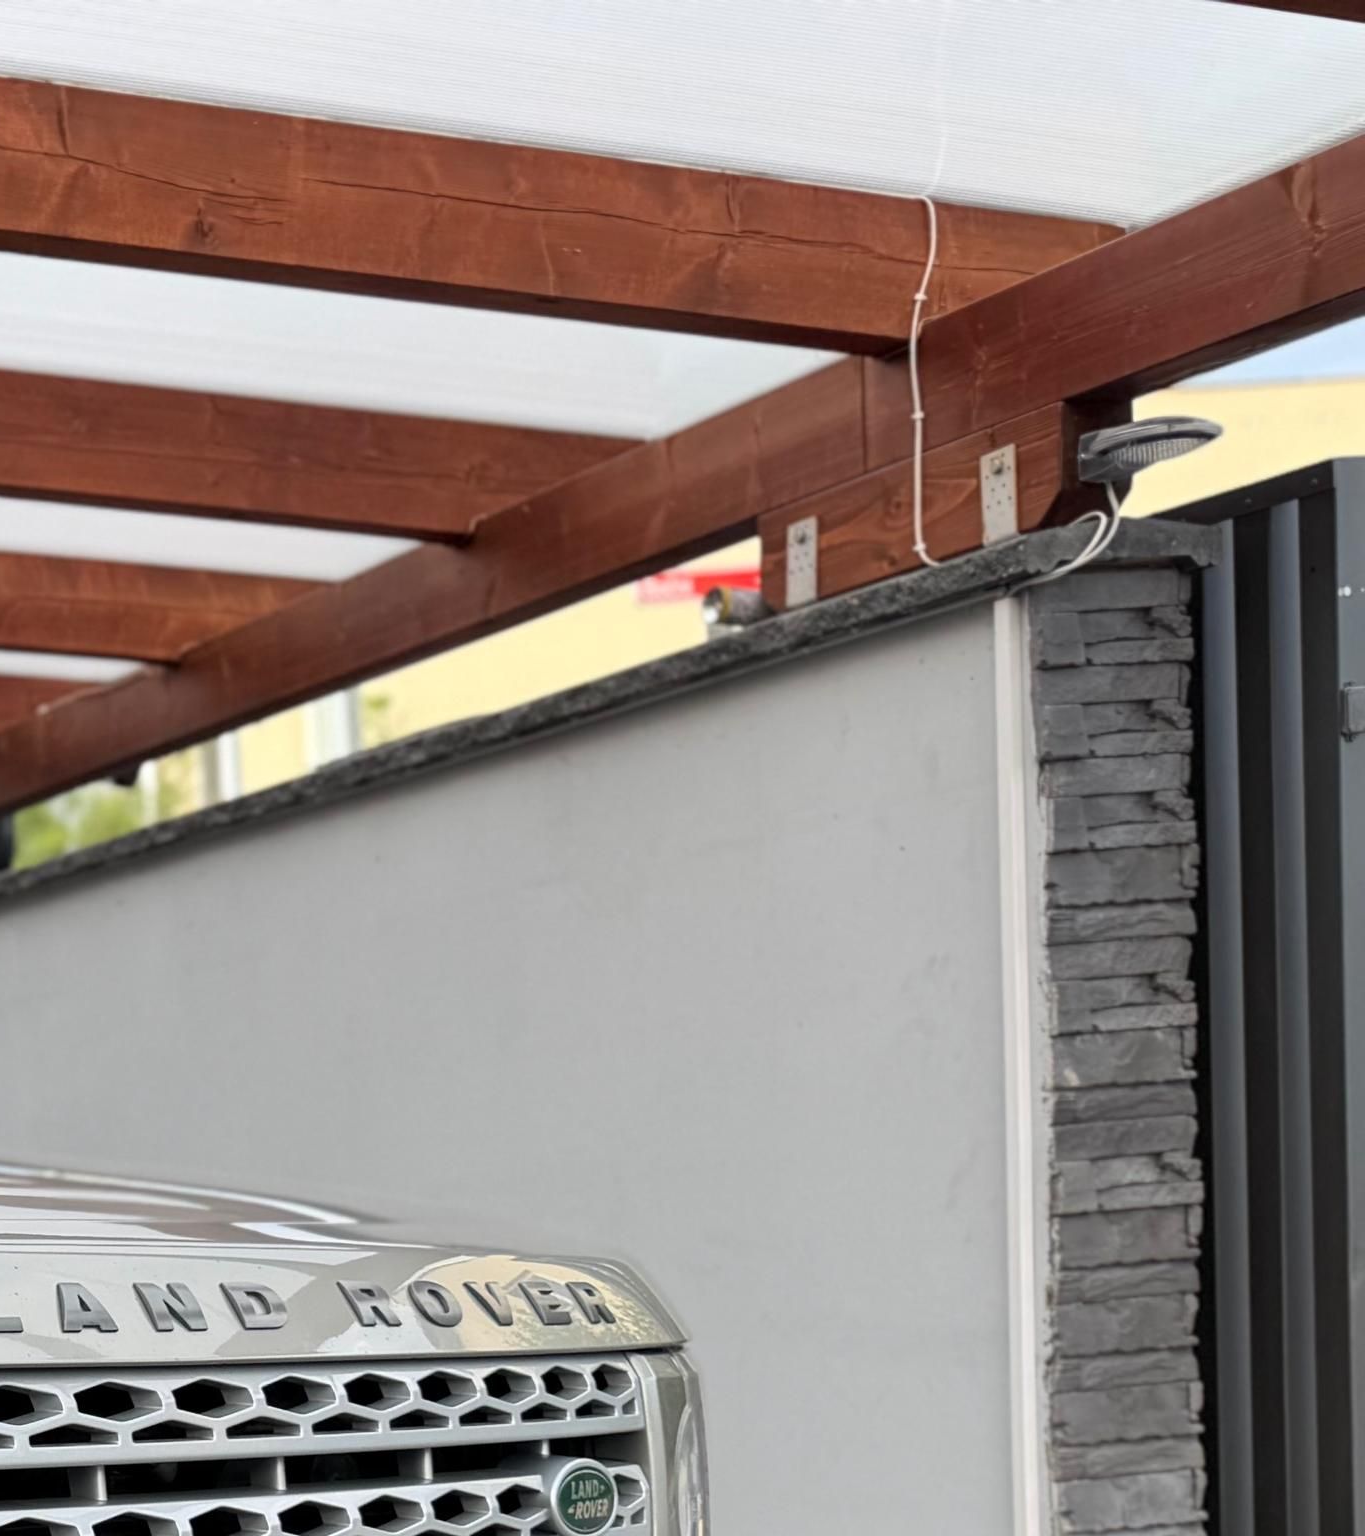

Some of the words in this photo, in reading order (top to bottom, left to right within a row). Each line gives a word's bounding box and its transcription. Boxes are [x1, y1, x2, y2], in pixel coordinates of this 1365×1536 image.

[336, 1281, 616, 1328] ROVER
[571, 1479, 599, 1499] LAND
[575, 1499, 609, 1520] ROVER
